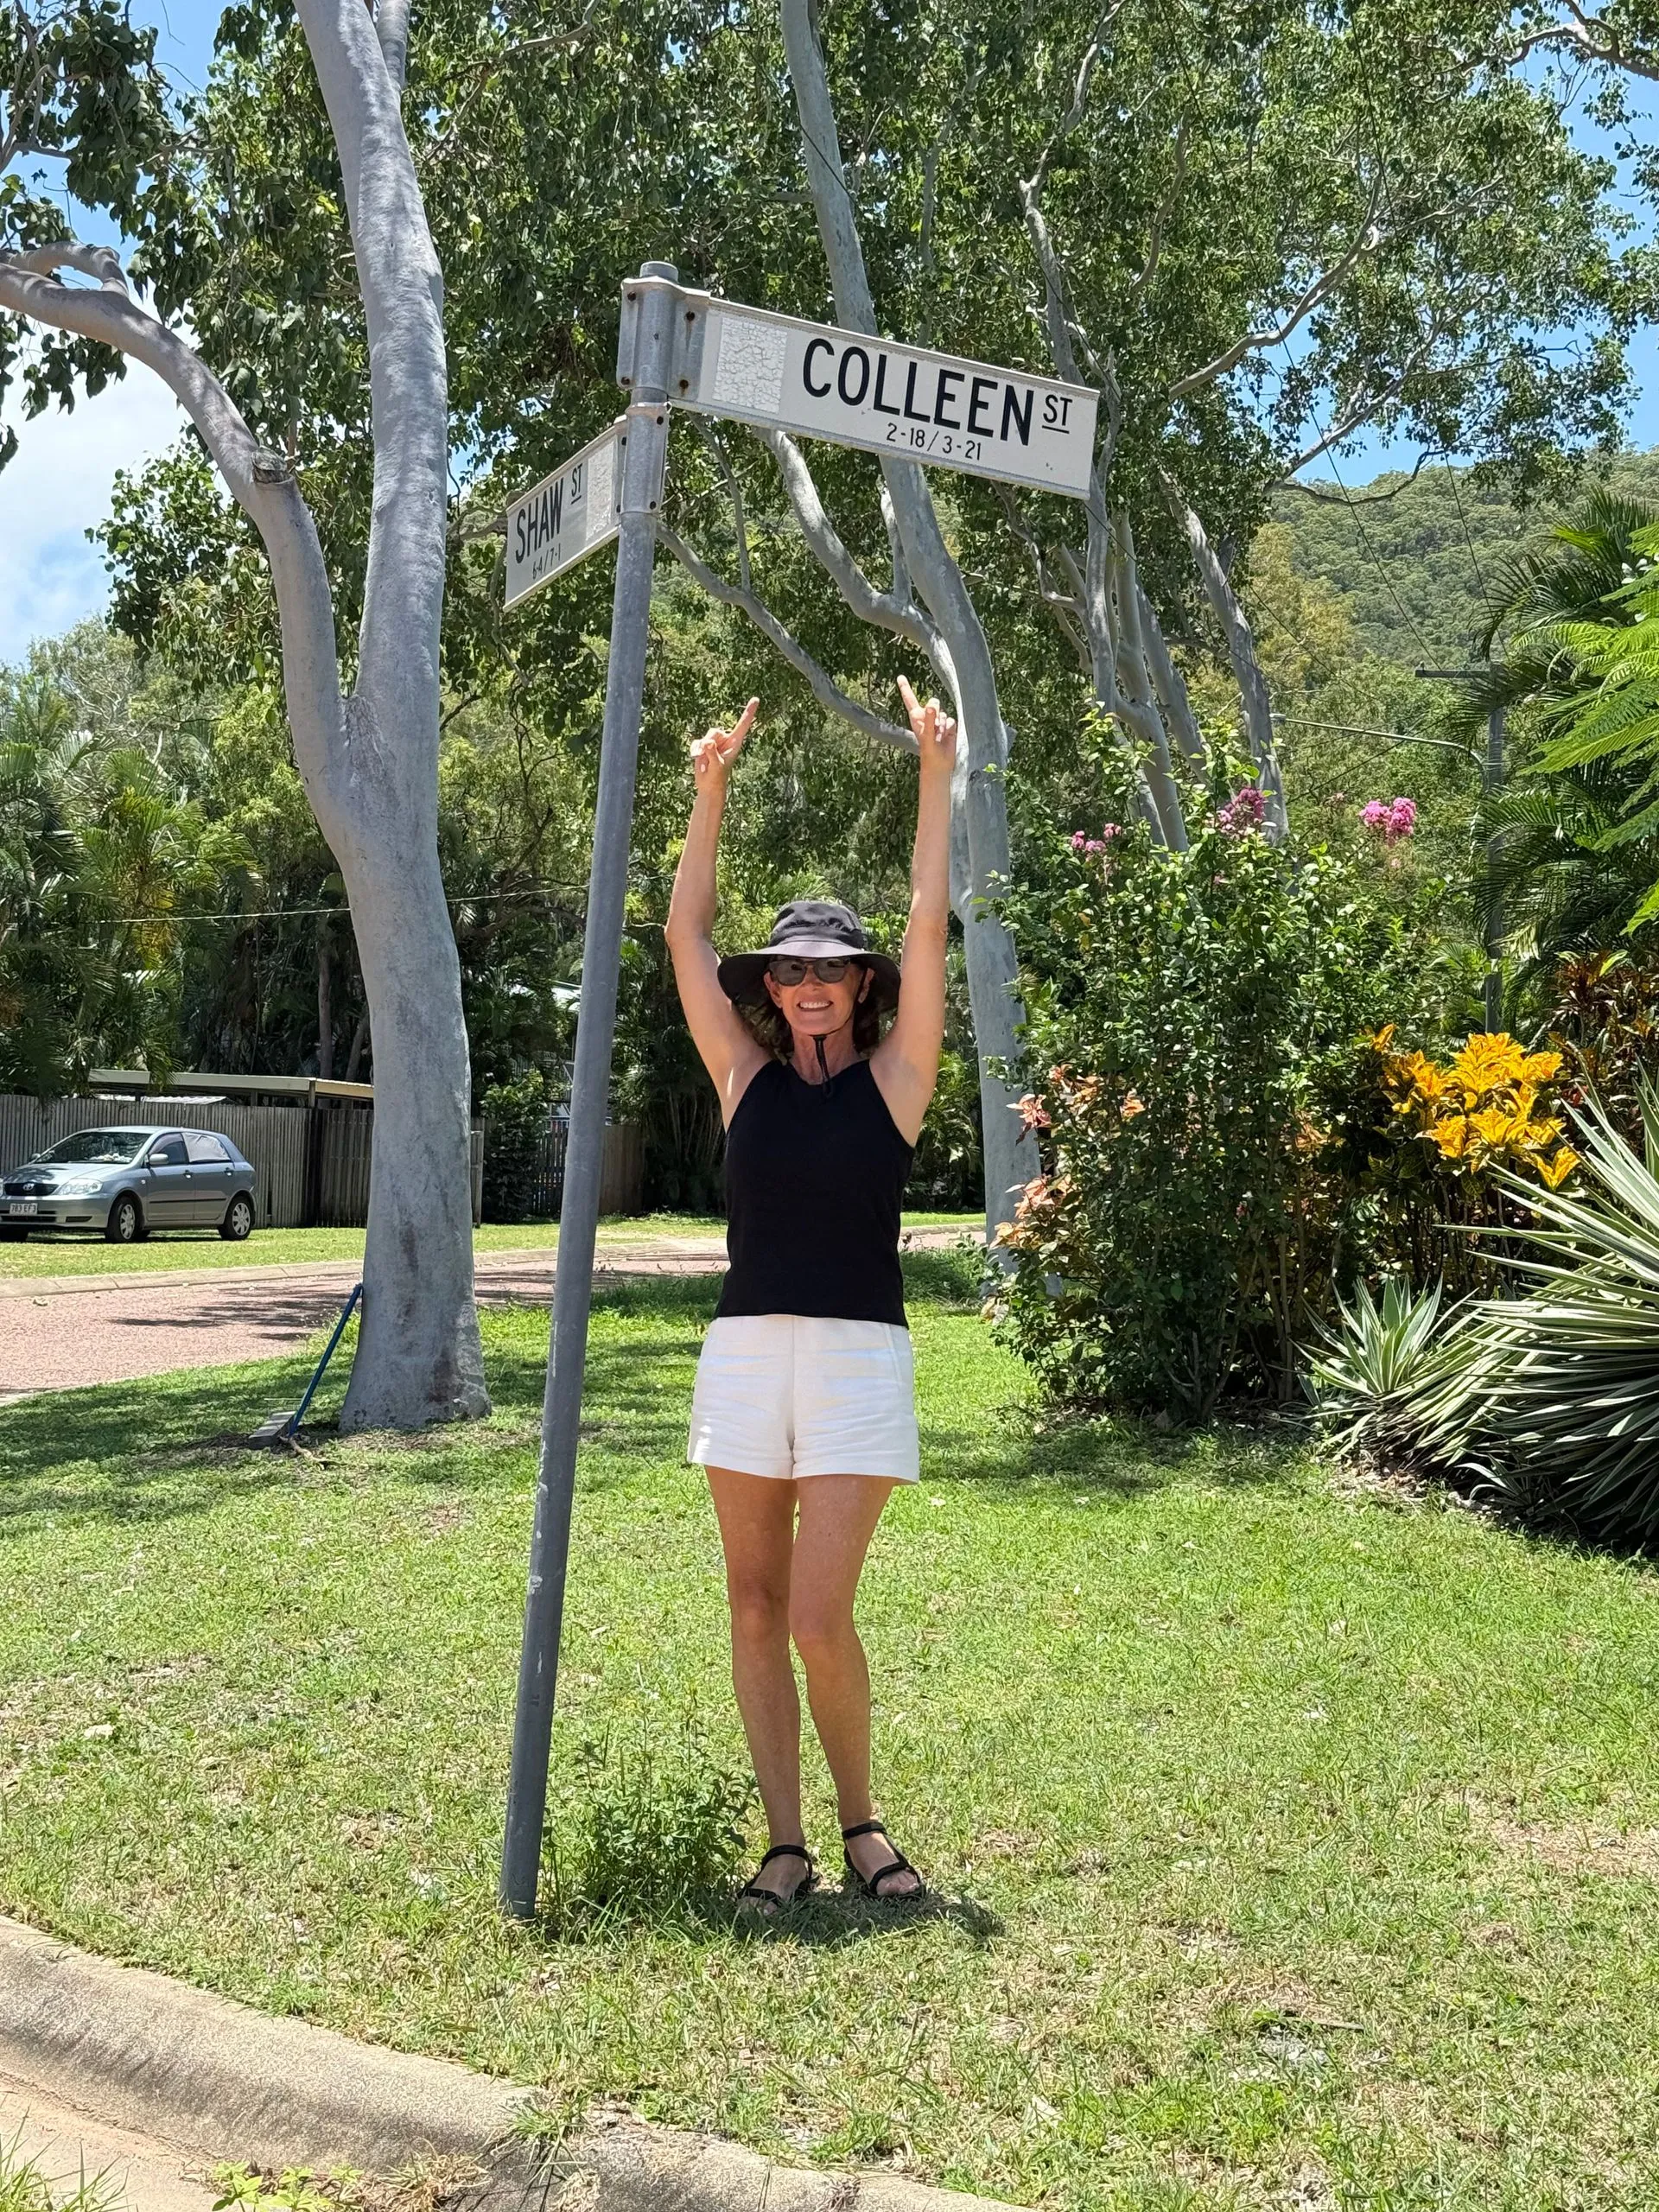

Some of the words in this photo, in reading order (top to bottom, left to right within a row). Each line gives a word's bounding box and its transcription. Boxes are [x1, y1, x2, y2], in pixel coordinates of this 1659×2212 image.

[803, 338, 1034, 446] COLLEEN
[1042, 394, 1073, 427] ST
[515, 477, 564, 564] SHAW
[571, 463, 583, 498] ST
